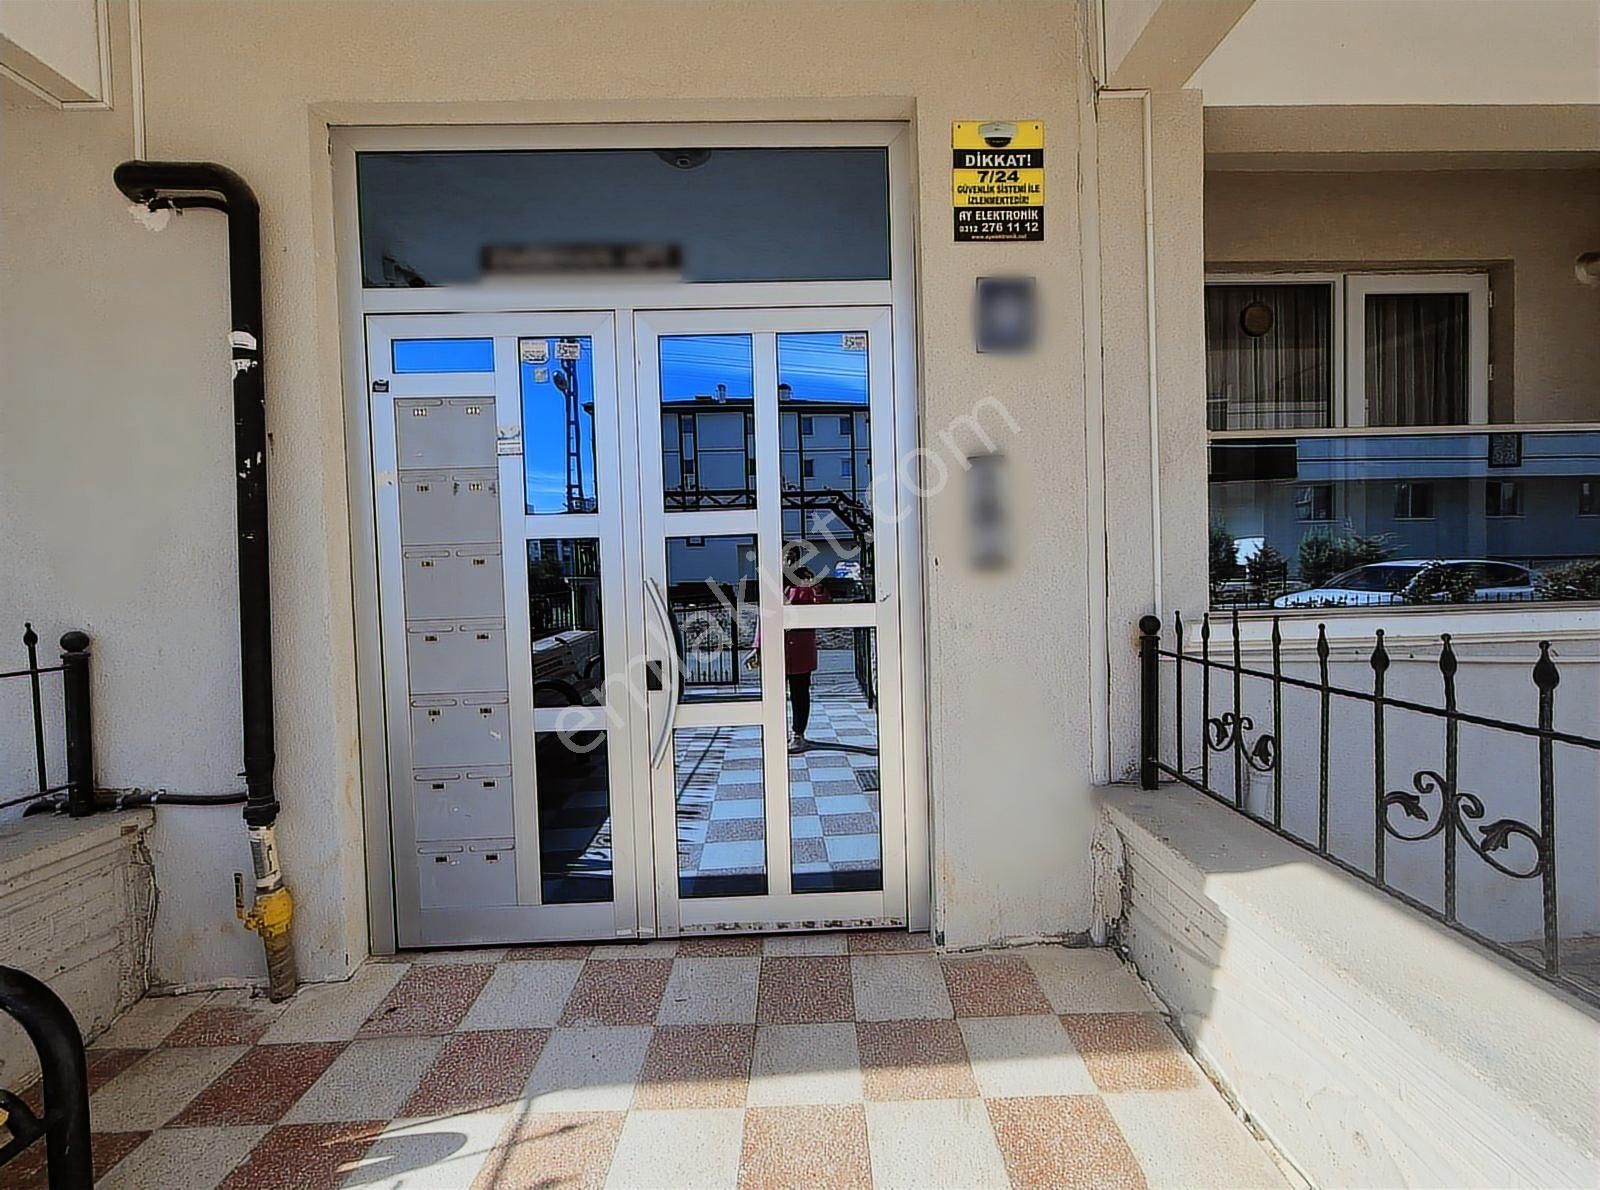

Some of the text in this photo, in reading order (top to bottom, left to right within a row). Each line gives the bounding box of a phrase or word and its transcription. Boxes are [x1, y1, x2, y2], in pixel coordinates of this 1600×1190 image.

[965, 152, 1031, 167] DİKKAT!
[977, 170, 1019, 183] 7/24
[957, 184, 994, 194] GÜVENLİK
[1028, 183, 1040, 193] İLE
[959, 208, 1038, 221] AY ELEKTRONİK
[959, 225, 978, 233] 0312
[1006, 222, 1020, 232] 11
[1024, 222, 1039, 232] 12
